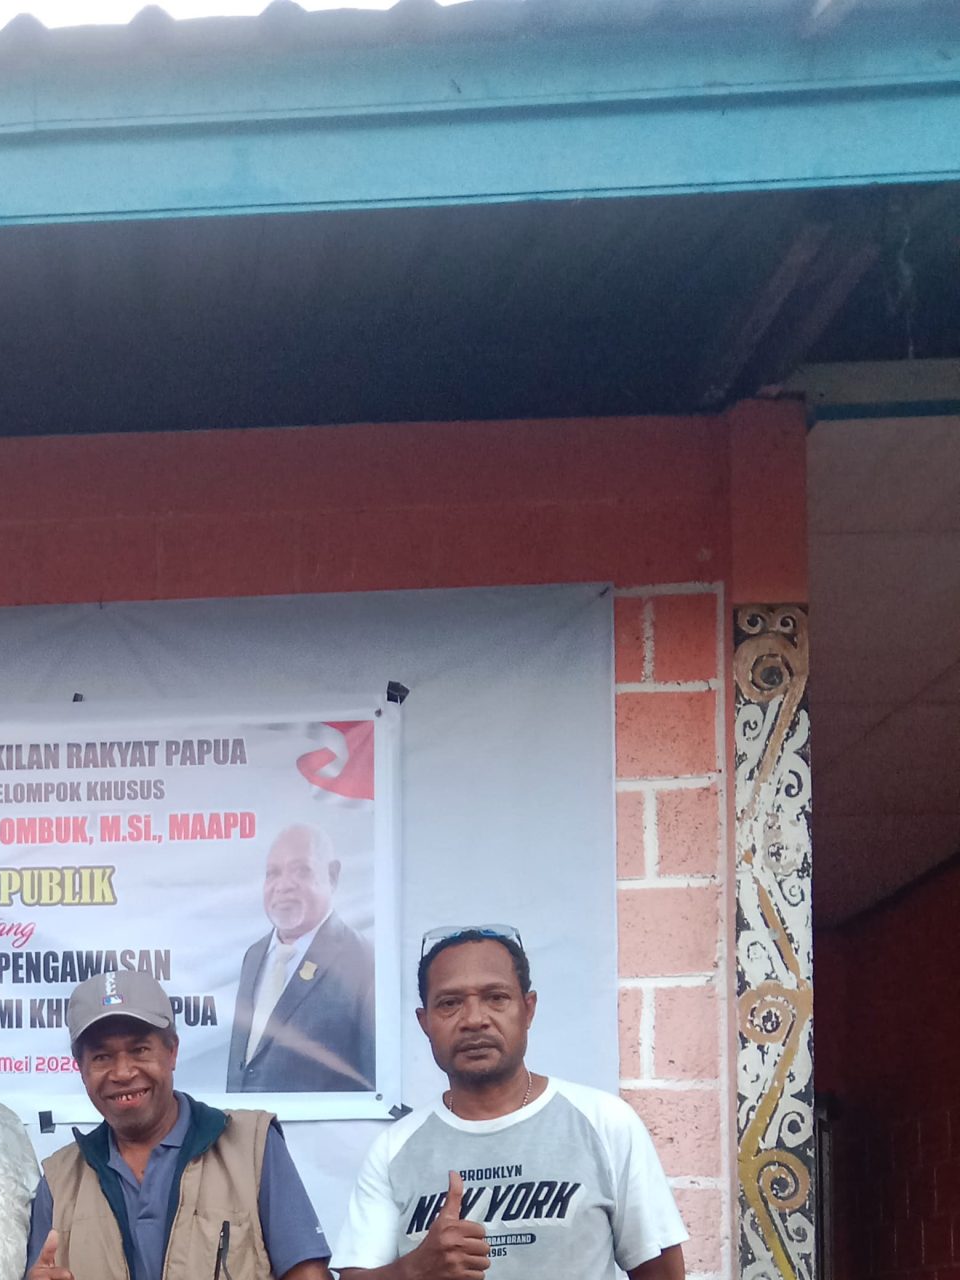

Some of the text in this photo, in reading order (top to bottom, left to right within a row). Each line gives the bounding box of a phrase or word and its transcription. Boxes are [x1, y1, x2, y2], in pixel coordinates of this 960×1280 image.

[66, 740, 159, 769] RAKYAT
[165, 738, 247, 766] PAPUA
[86, 779, 165, 801] KHUSUS
[100, 814, 163, 843] M.Si.,
[168, 811, 256, 841] MAAPD
[169, 996, 218, 1027] PUA
[459, 1165, 523, 1182] BROOKLYN
[484, 1181, 581, 1222] YORK
